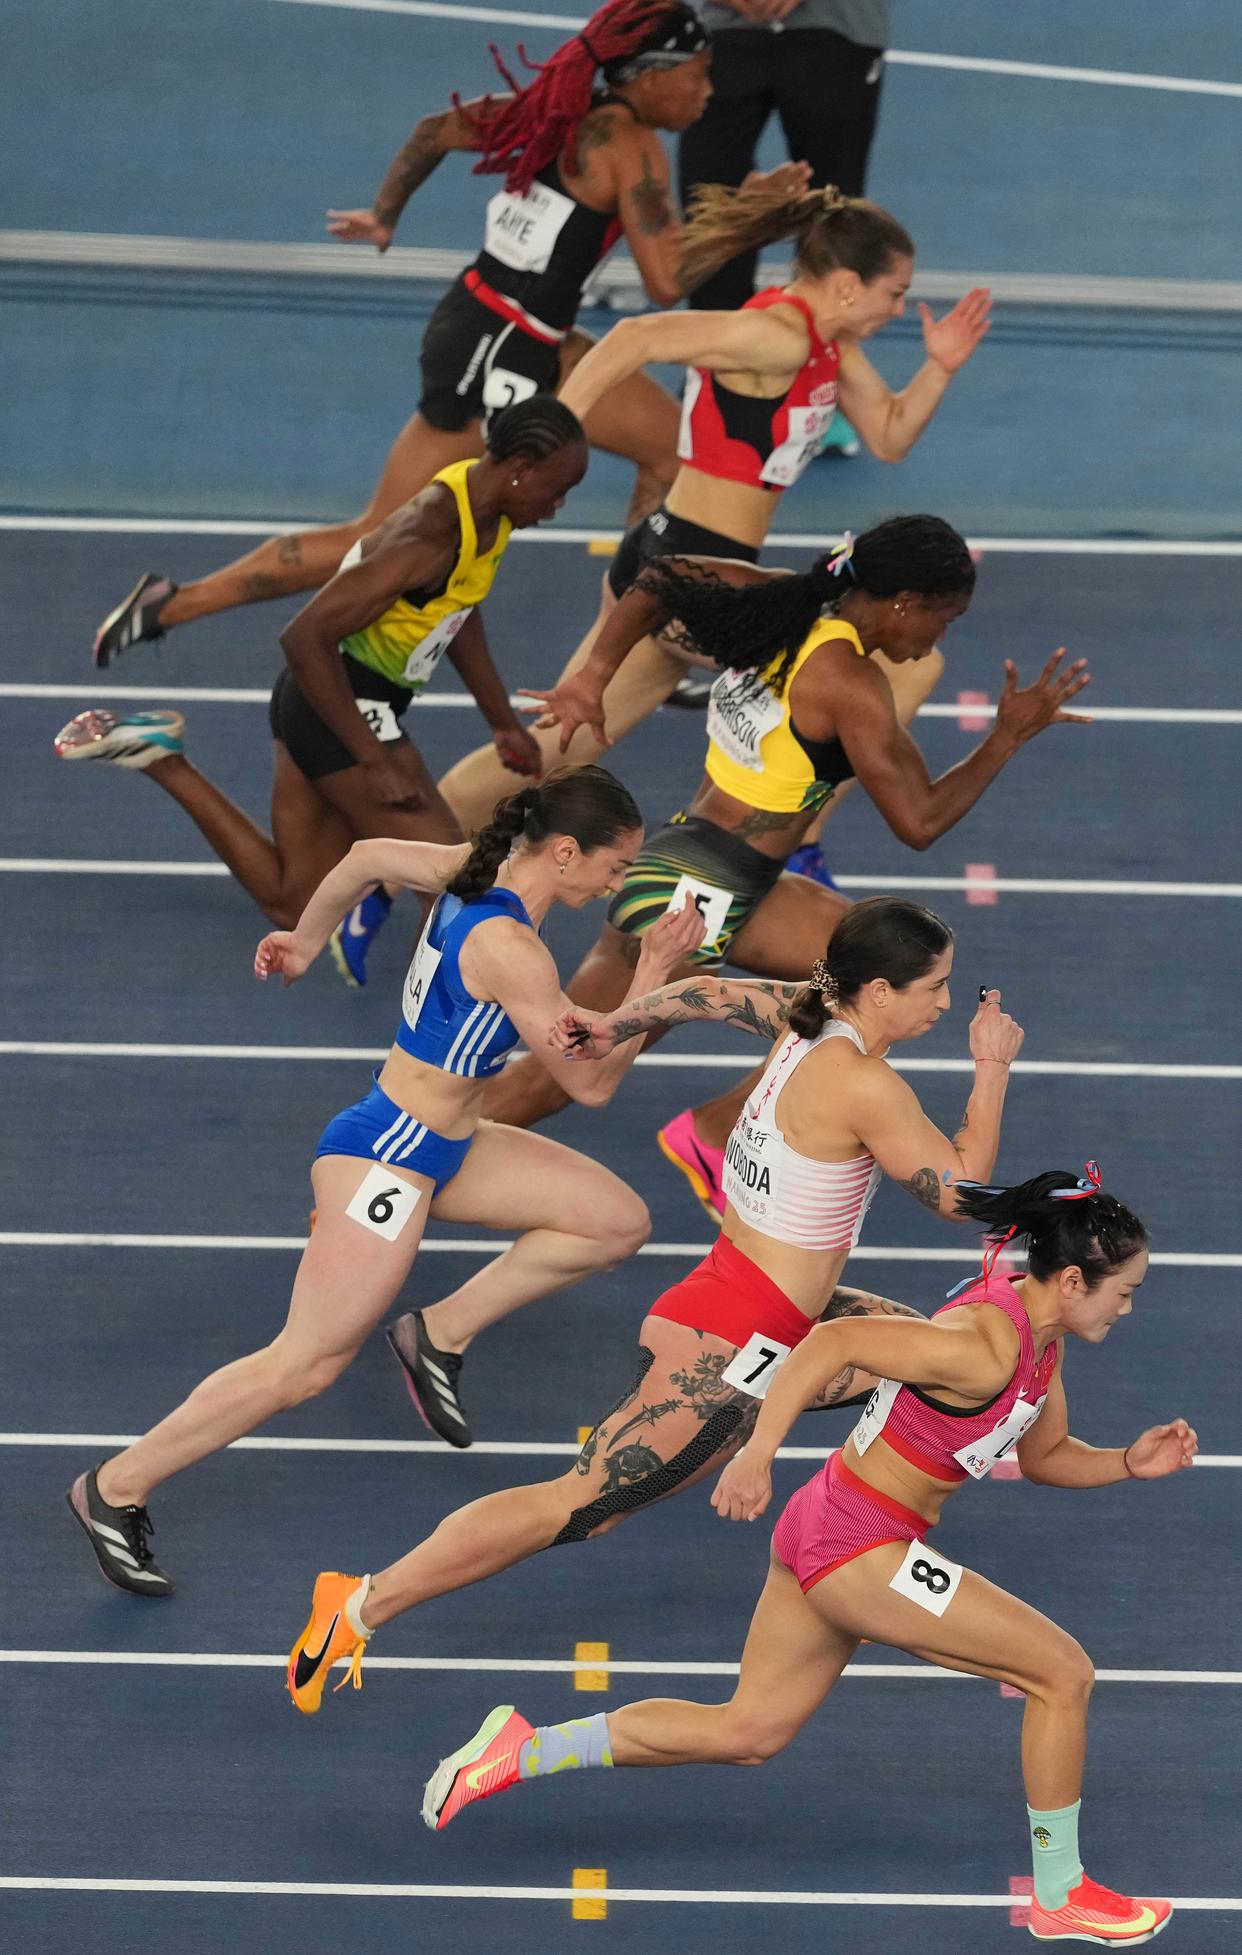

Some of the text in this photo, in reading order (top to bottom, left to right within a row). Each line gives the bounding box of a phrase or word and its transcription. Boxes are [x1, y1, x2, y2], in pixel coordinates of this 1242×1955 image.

[695, 893, 712, 921] 5
[368, 1188, 402, 1223] 6
[752, 1199, 767, 1215] 25
[742, 1347, 778, 1384] 7
[911, 1559, 950, 1594] 8
